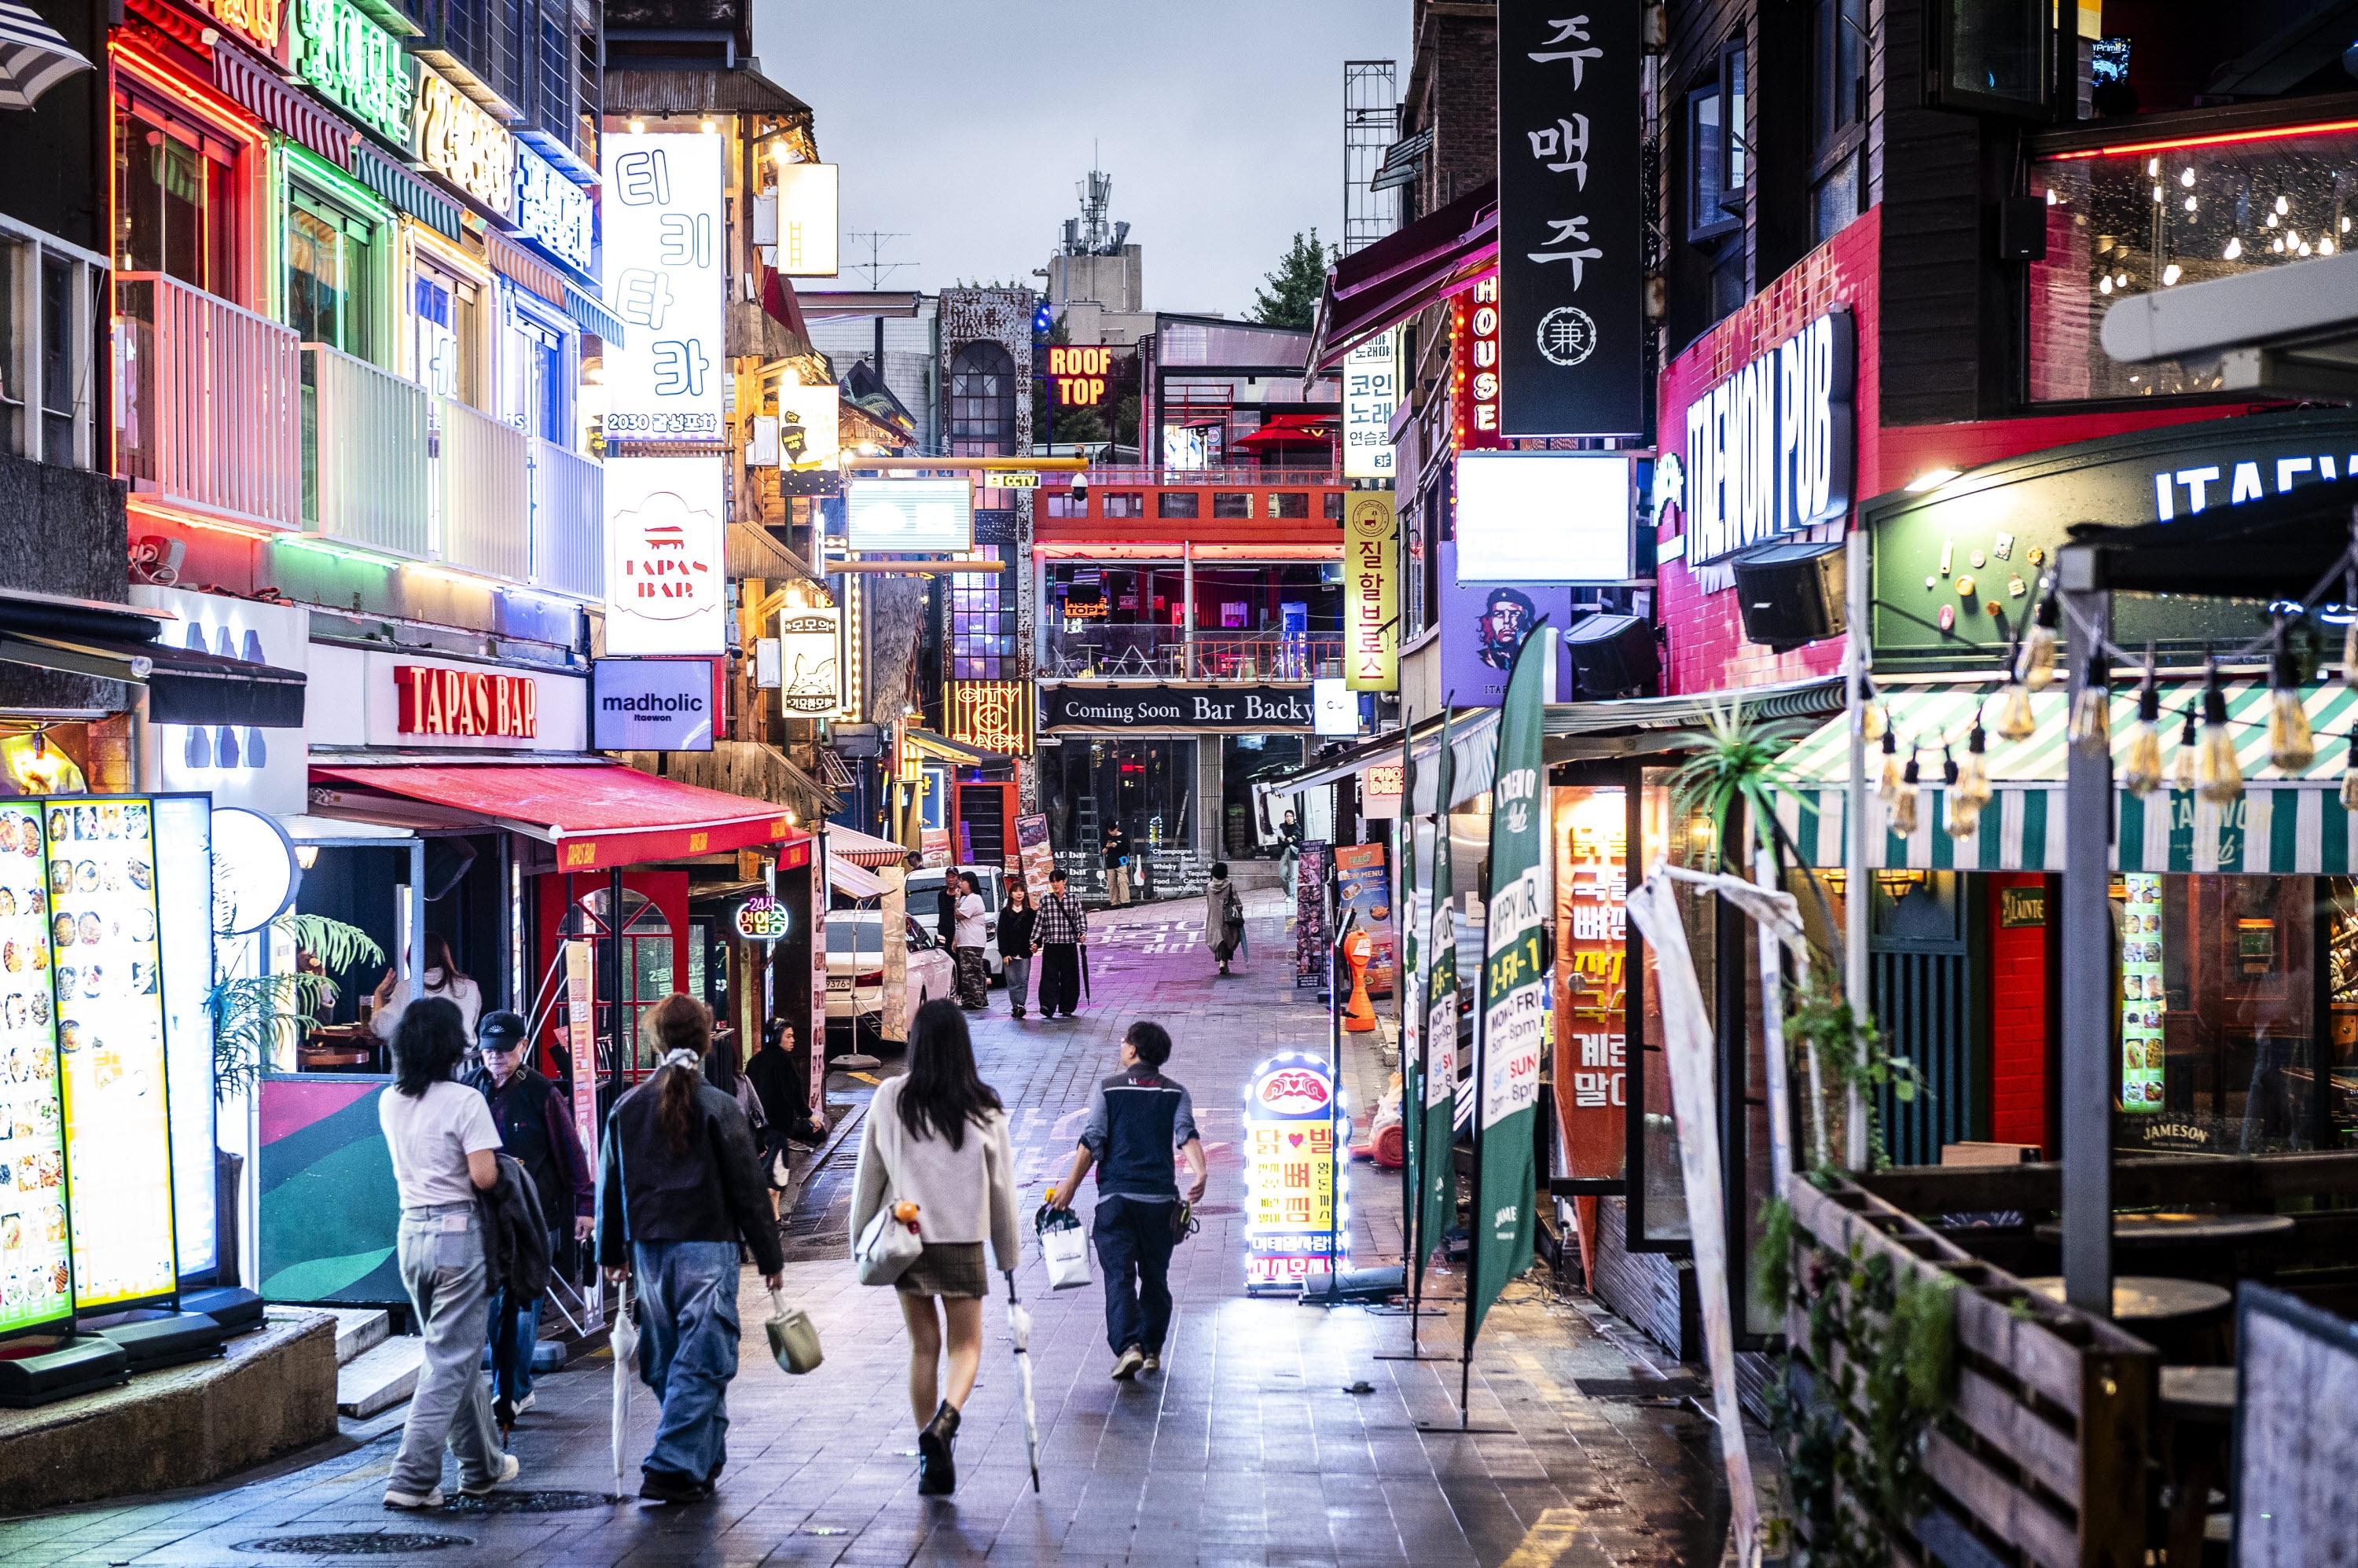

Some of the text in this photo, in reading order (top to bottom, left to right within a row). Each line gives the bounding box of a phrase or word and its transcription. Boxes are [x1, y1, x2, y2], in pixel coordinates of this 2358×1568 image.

[1528, 15, 1603, 292] 주맥주
[615, 149, 710, 396] 티키타카
[1050, 347, 1111, 376] ROOF
[1474, 276, 1498, 431] HOUSE
[1058, 378, 1105, 405] TOP
[1350, 373, 1392, 397] 코인
[608, 413, 649, 430] 2030
[1350, 402, 1392, 424] 노래
[1780, 314, 1834, 532] PUB
[1376, 454, 1390, 468] 3F
[1005, 475, 1036, 487] CCTV
[626, 560, 708, 575] TAPAS
[791, 619, 830, 632] 모모의
[395, 666, 537, 739] TAPAS BAR
[603, 693, 703, 712] madholic
[958, 687, 1019, 703] CITY
[1065, 701, 1133, 724] Coming
[1138, 702, 1181, 718] Soon
[1192, 696, 1236, 721] Bar
[750, 898, 775, 913] 24시
[740, 911, 786, 934] 영업중
[2143, 1125, 2207, 1142] JAMESON
